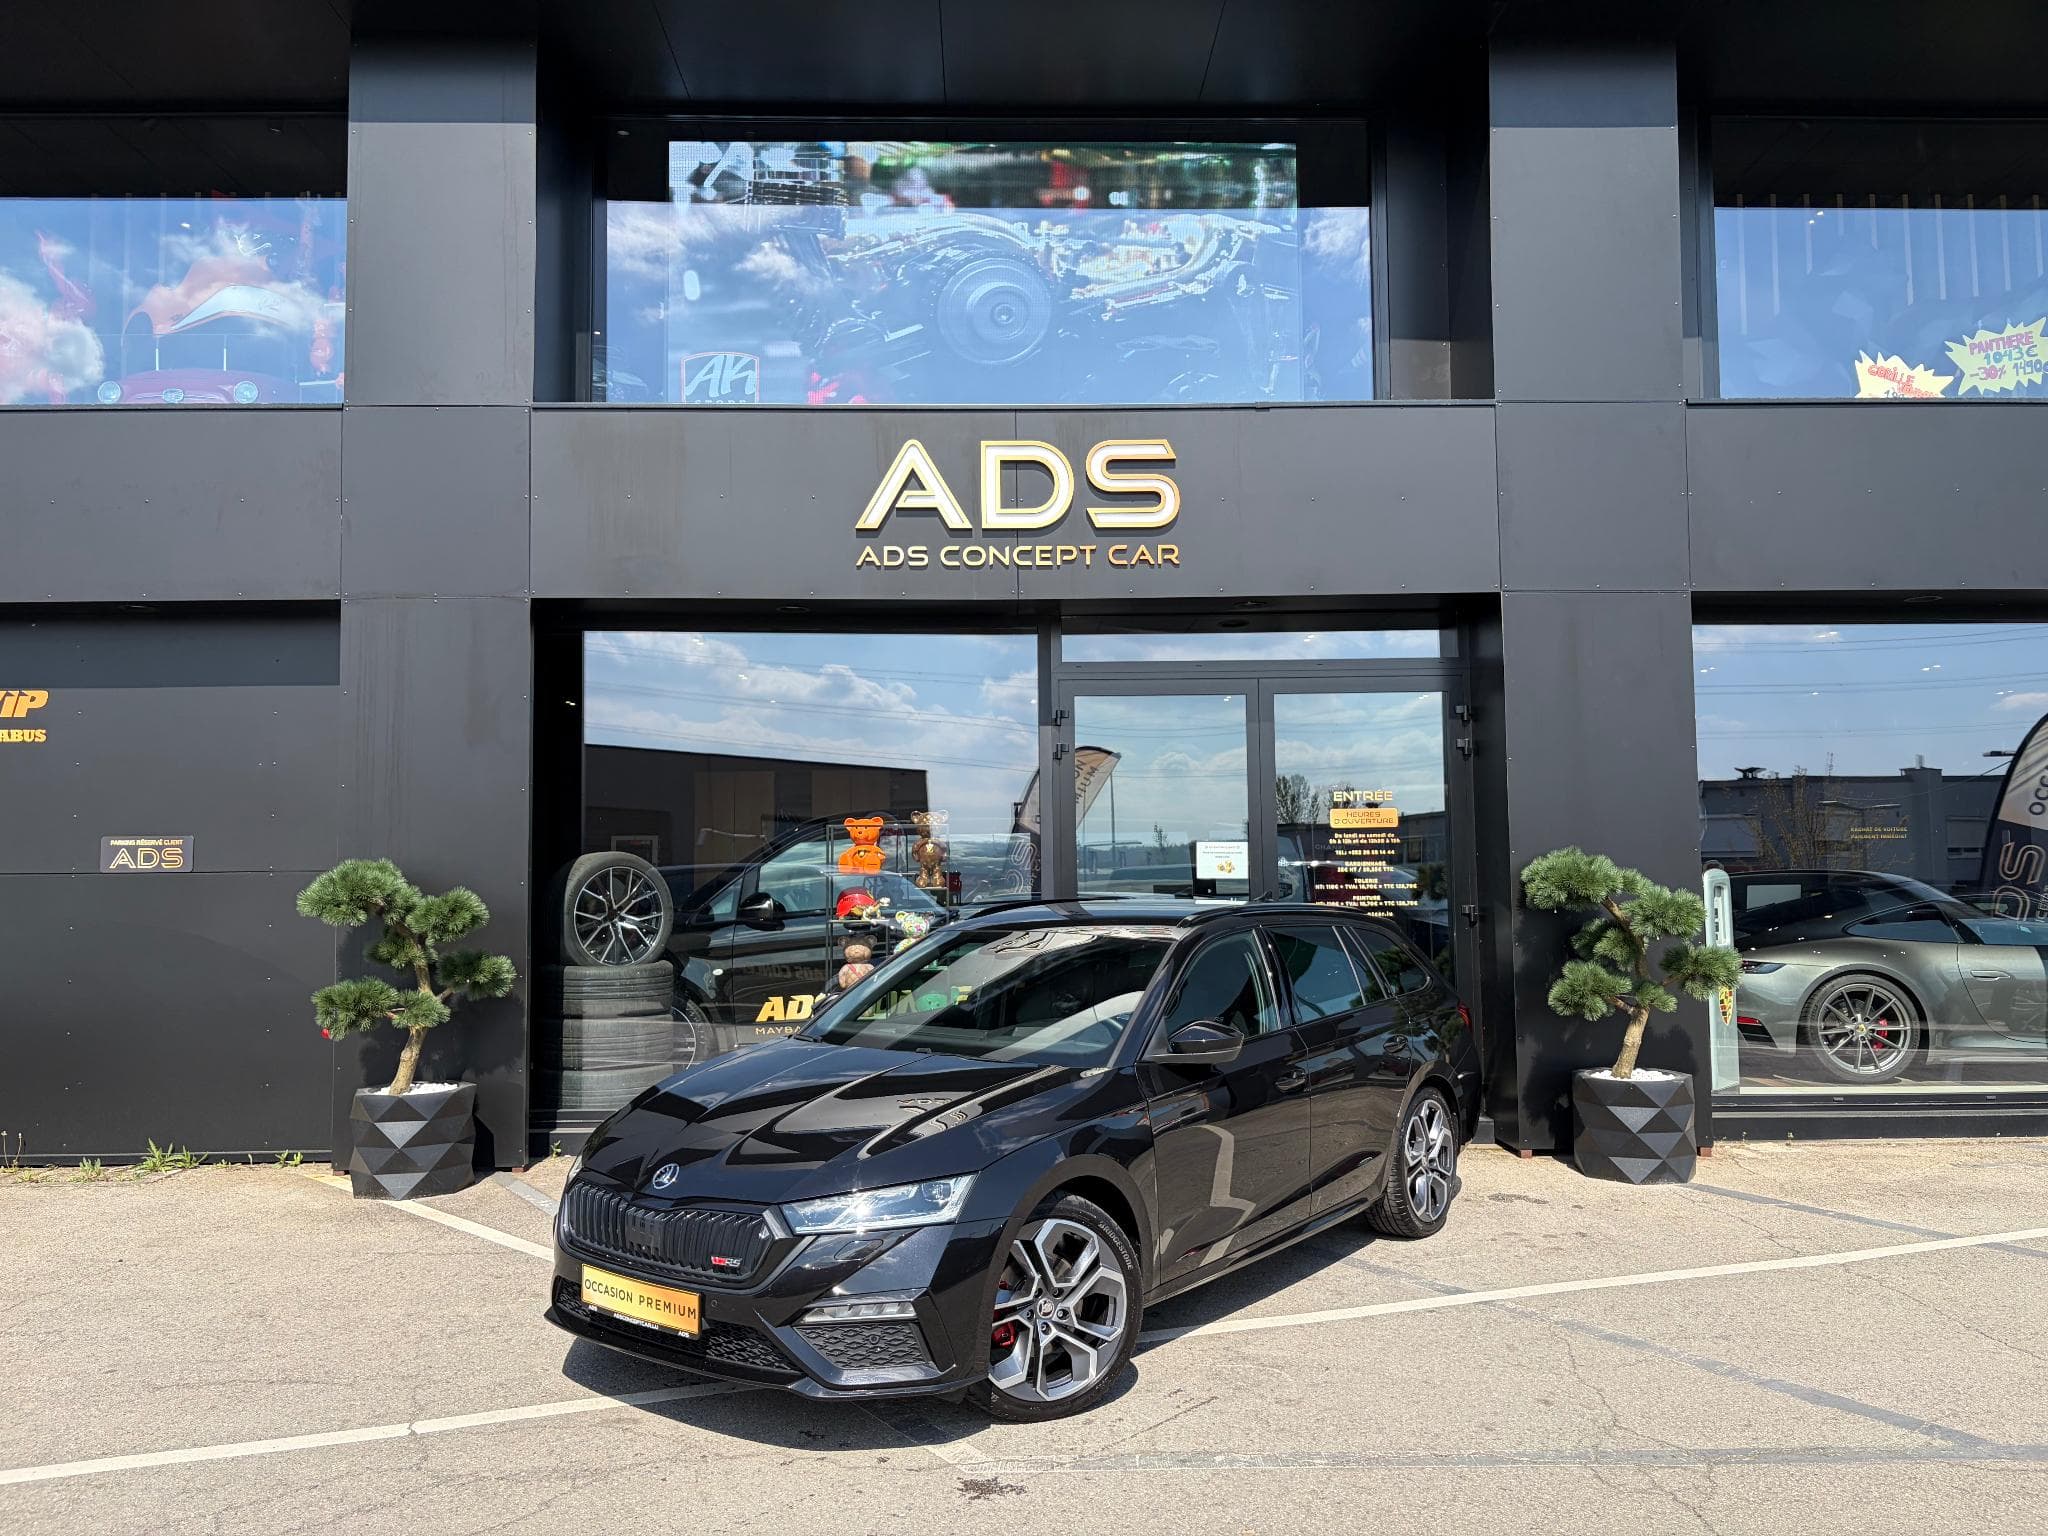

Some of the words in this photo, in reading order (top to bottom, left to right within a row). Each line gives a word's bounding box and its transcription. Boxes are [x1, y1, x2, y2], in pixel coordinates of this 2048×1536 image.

[855, 439, 1180, 528] ADS
[856, 546, 928, 566] ADS
[940, 546, 1096, 566] CONCEPT
[1108, 544, 1180, 565] CAR
[1333, 790, 1393, 801] ENTRÉE
[109, 847, 183, 869] ADS
[584, 1278, 633, 1304] OCCASION
[639, 1294, 697, 1320] PREMIUM
